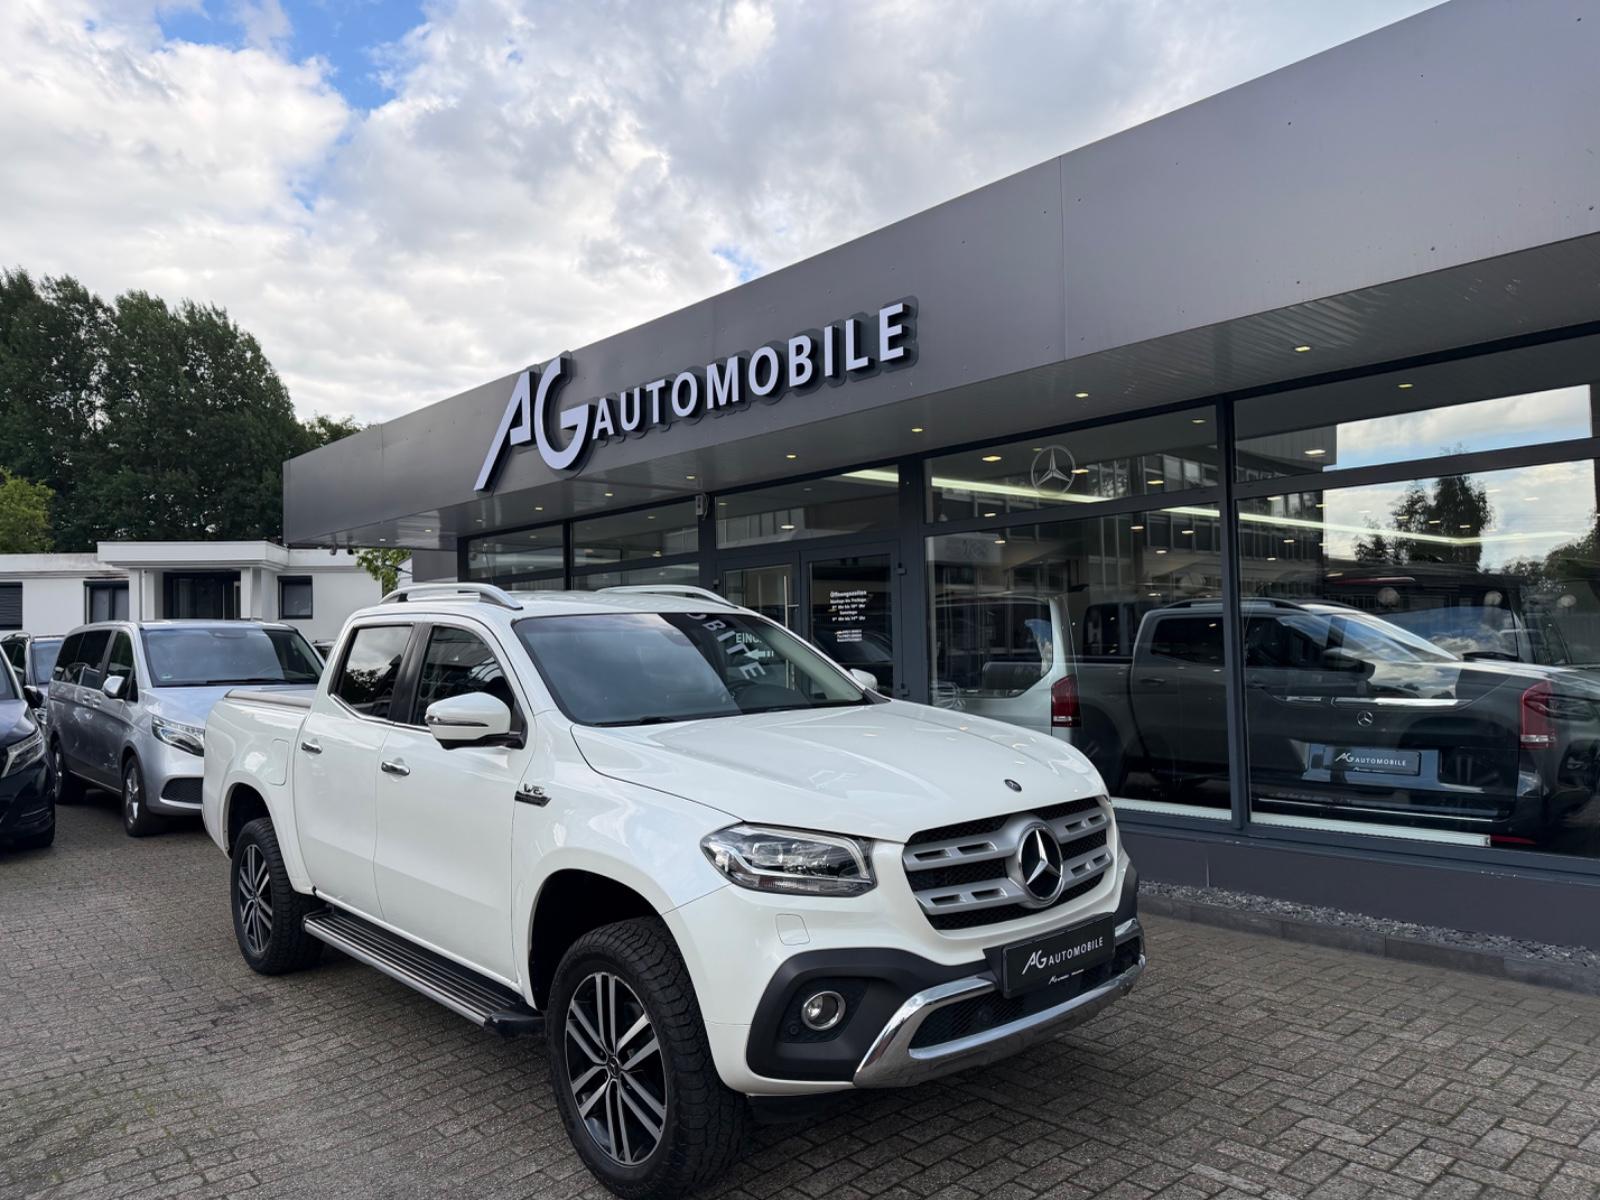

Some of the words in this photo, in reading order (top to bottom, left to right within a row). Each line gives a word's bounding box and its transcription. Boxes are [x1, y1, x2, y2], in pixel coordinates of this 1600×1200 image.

[474, 357, 589, 491] AG
[592, 302, 905, 440] AUTOMOBILE
[735, 632, 762, 643] EIN
[1355, 757, 1406, 766] AUTOMOBILE
[1048, 937, 1104, 966] AUTOMOBILE
